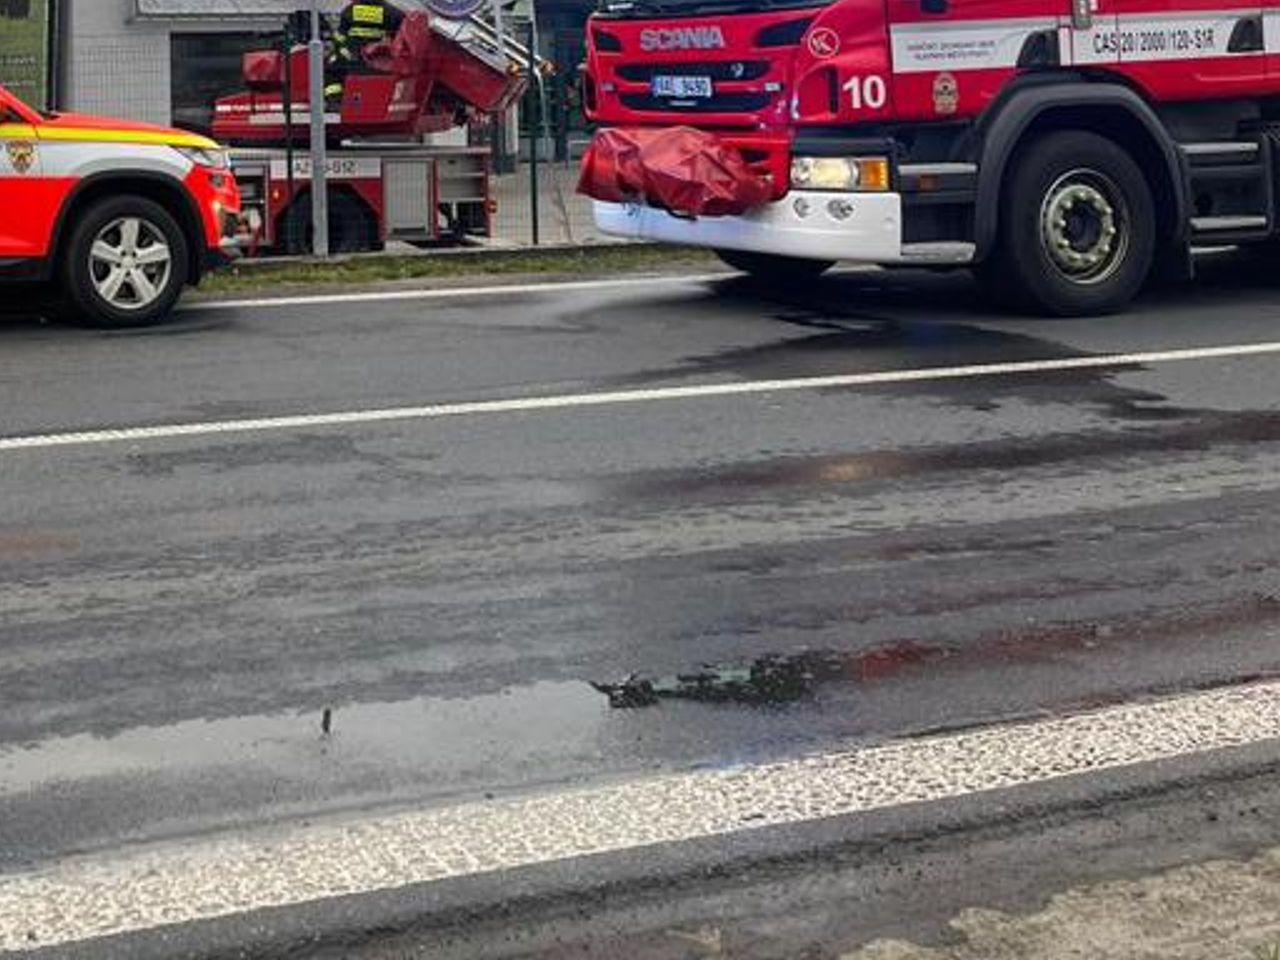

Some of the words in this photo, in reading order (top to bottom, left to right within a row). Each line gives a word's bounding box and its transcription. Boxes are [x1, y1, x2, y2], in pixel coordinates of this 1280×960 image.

[639, 25, 726, 51] SCANIA
[1093, 31, 1117, 54] CAS
[842, 75, 886, 109] 10
